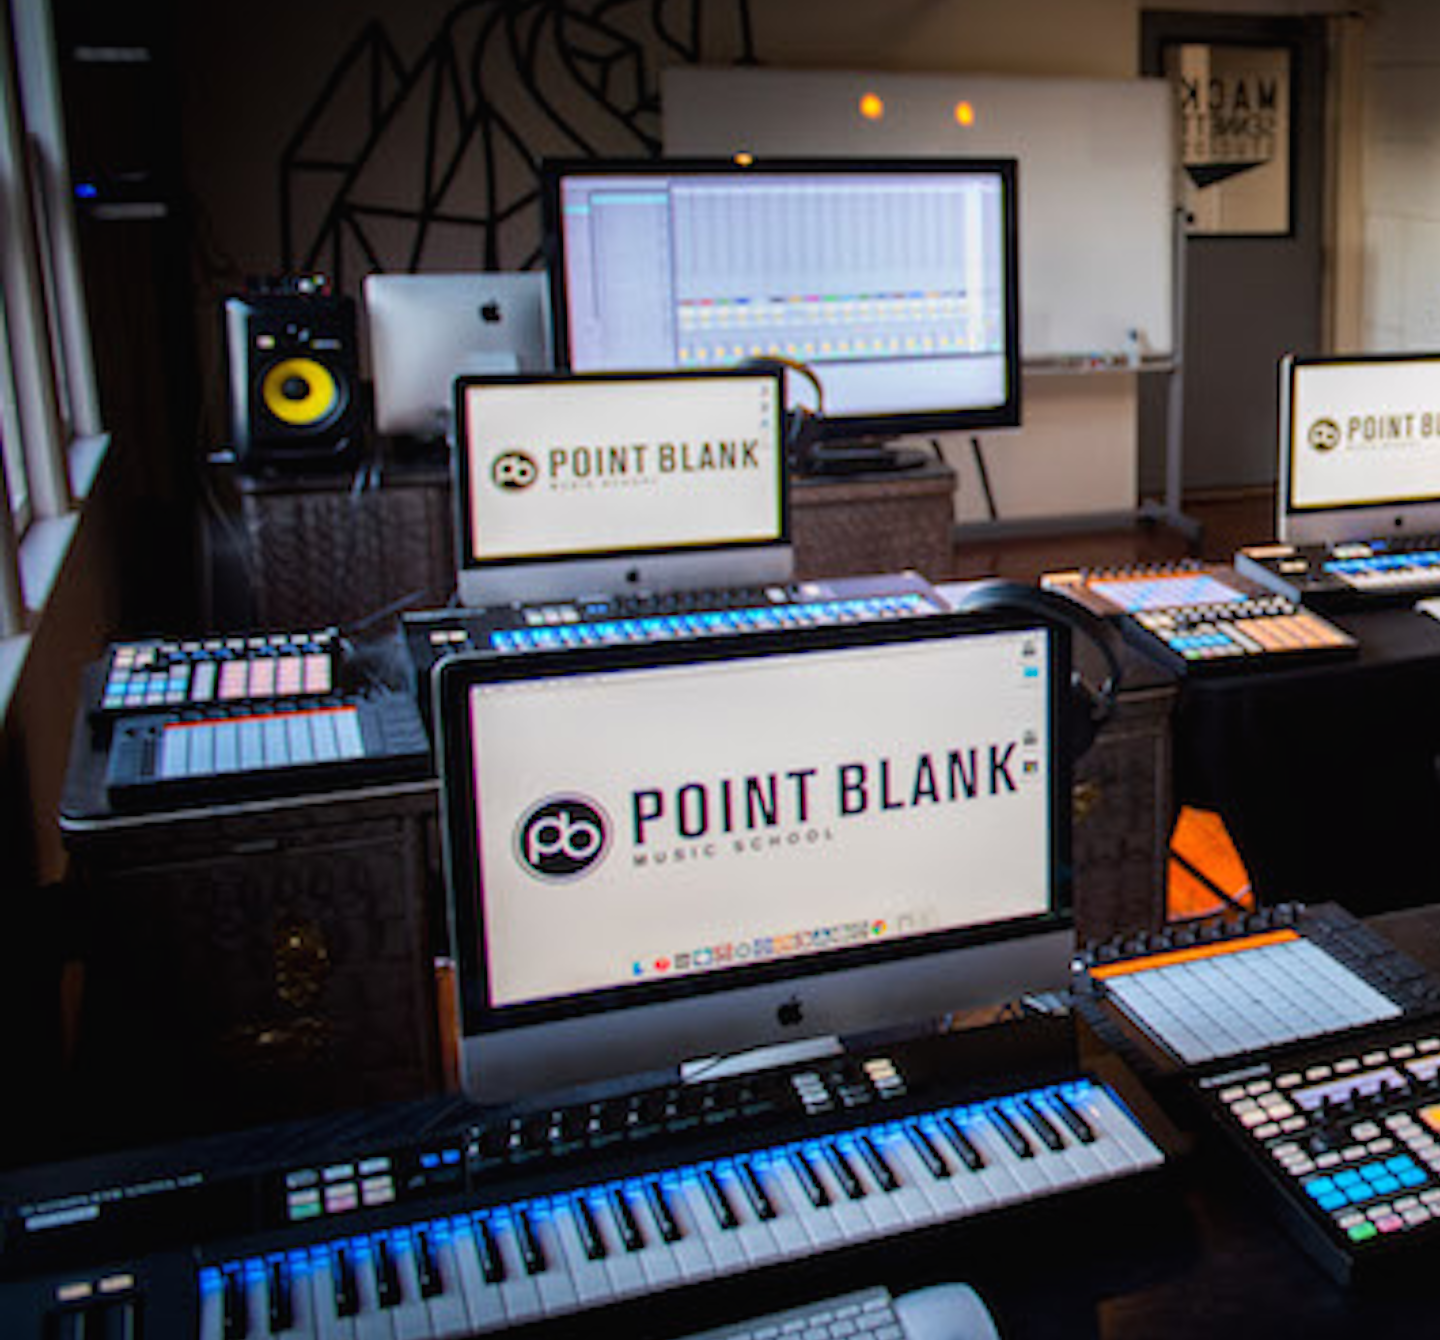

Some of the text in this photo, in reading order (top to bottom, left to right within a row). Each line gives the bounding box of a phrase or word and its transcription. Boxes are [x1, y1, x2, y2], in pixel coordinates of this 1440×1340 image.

[1347, 413, 1415, 442] POINT
[549, 444, 649, 479] POINT
[658, 438, 760, 472] BLANK
[630, 767, 819, 847] POINT
[836, 740, 1019, 819] BLANK
[633, 827, 836, 868] MUSIC SCHOOL
